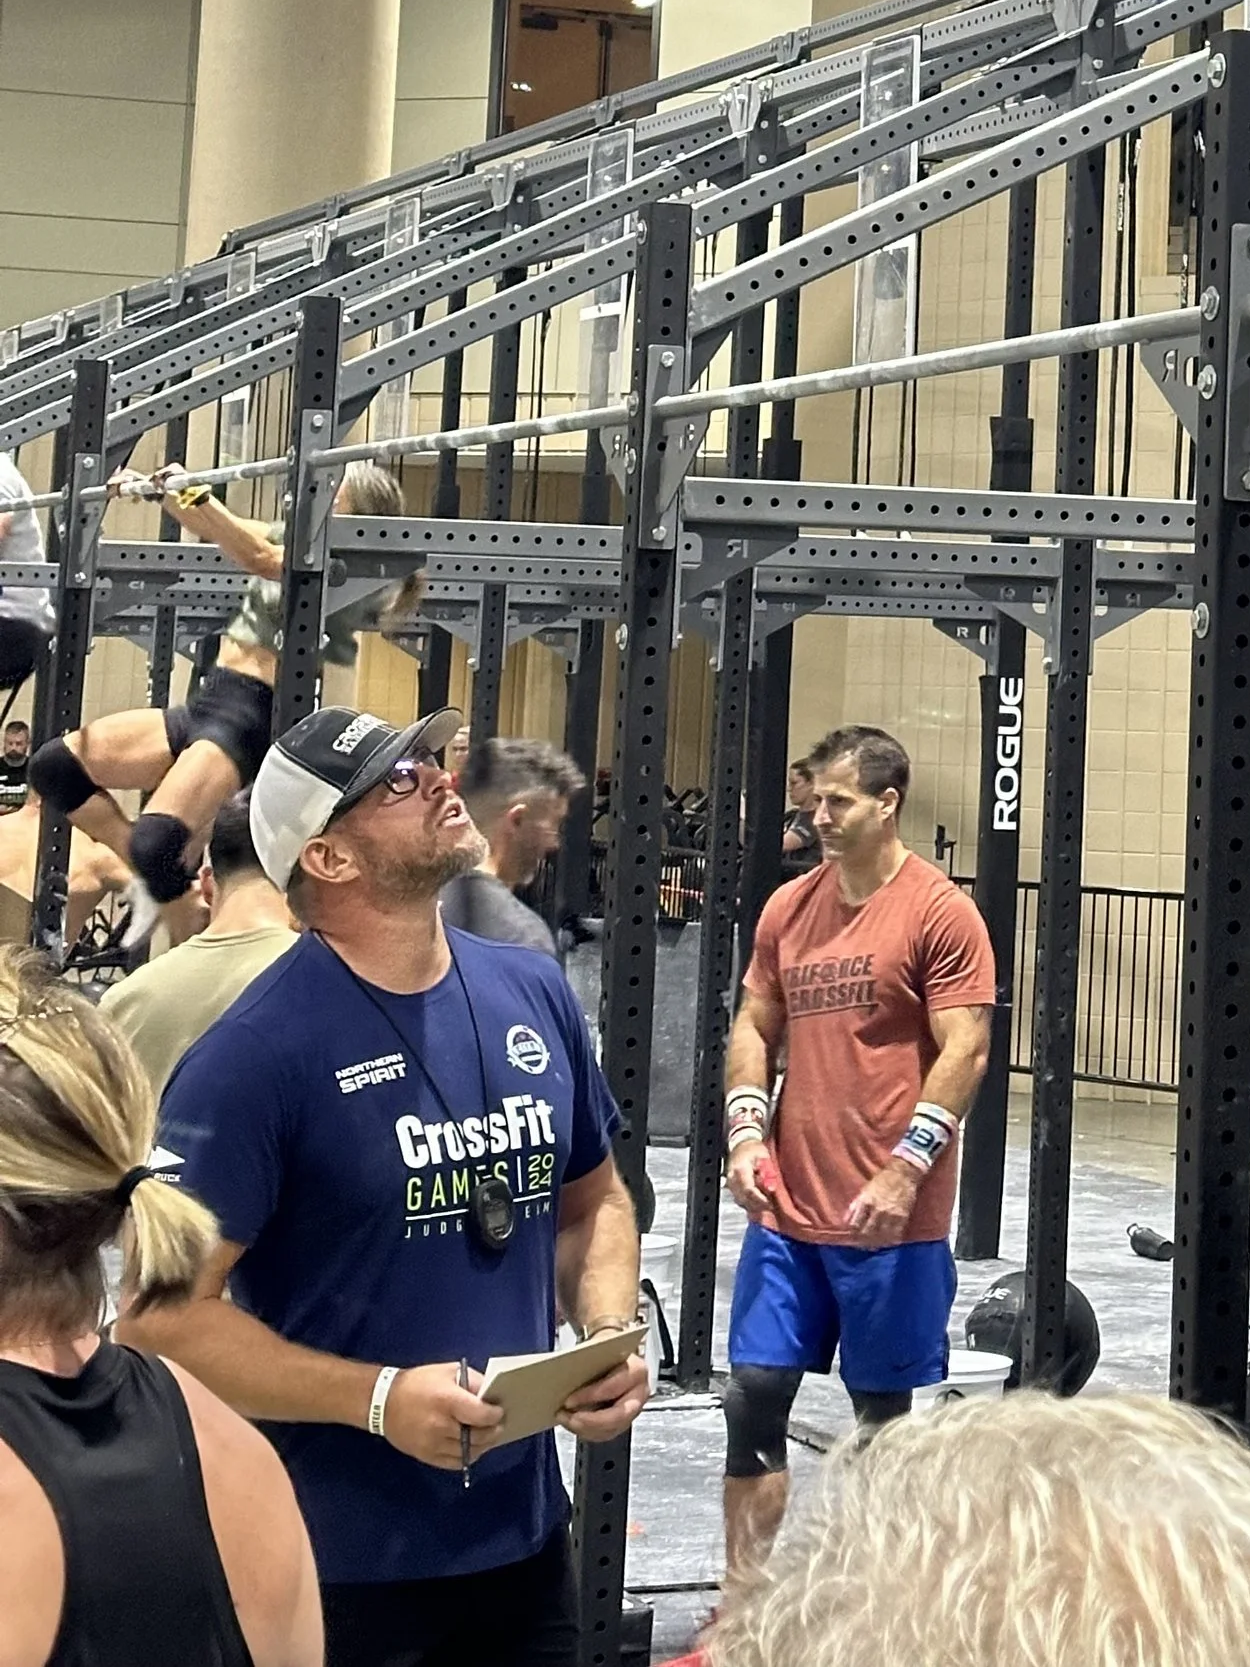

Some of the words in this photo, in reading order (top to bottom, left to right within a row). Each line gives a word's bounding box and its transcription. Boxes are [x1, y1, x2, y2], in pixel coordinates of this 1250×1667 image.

[993, 677, 1024, 831] ROGUE
[335, 1053, 403, 1079] NORTHERN
[339, 1062, 406, 1093] SPIRIT
[395, 1094, 556, 1169] CrossFit
[528, 1154, 555, 1172] 20
[528, 1171, 552, 1190] 24
[404, 1219, 463, 1239] JUDG
